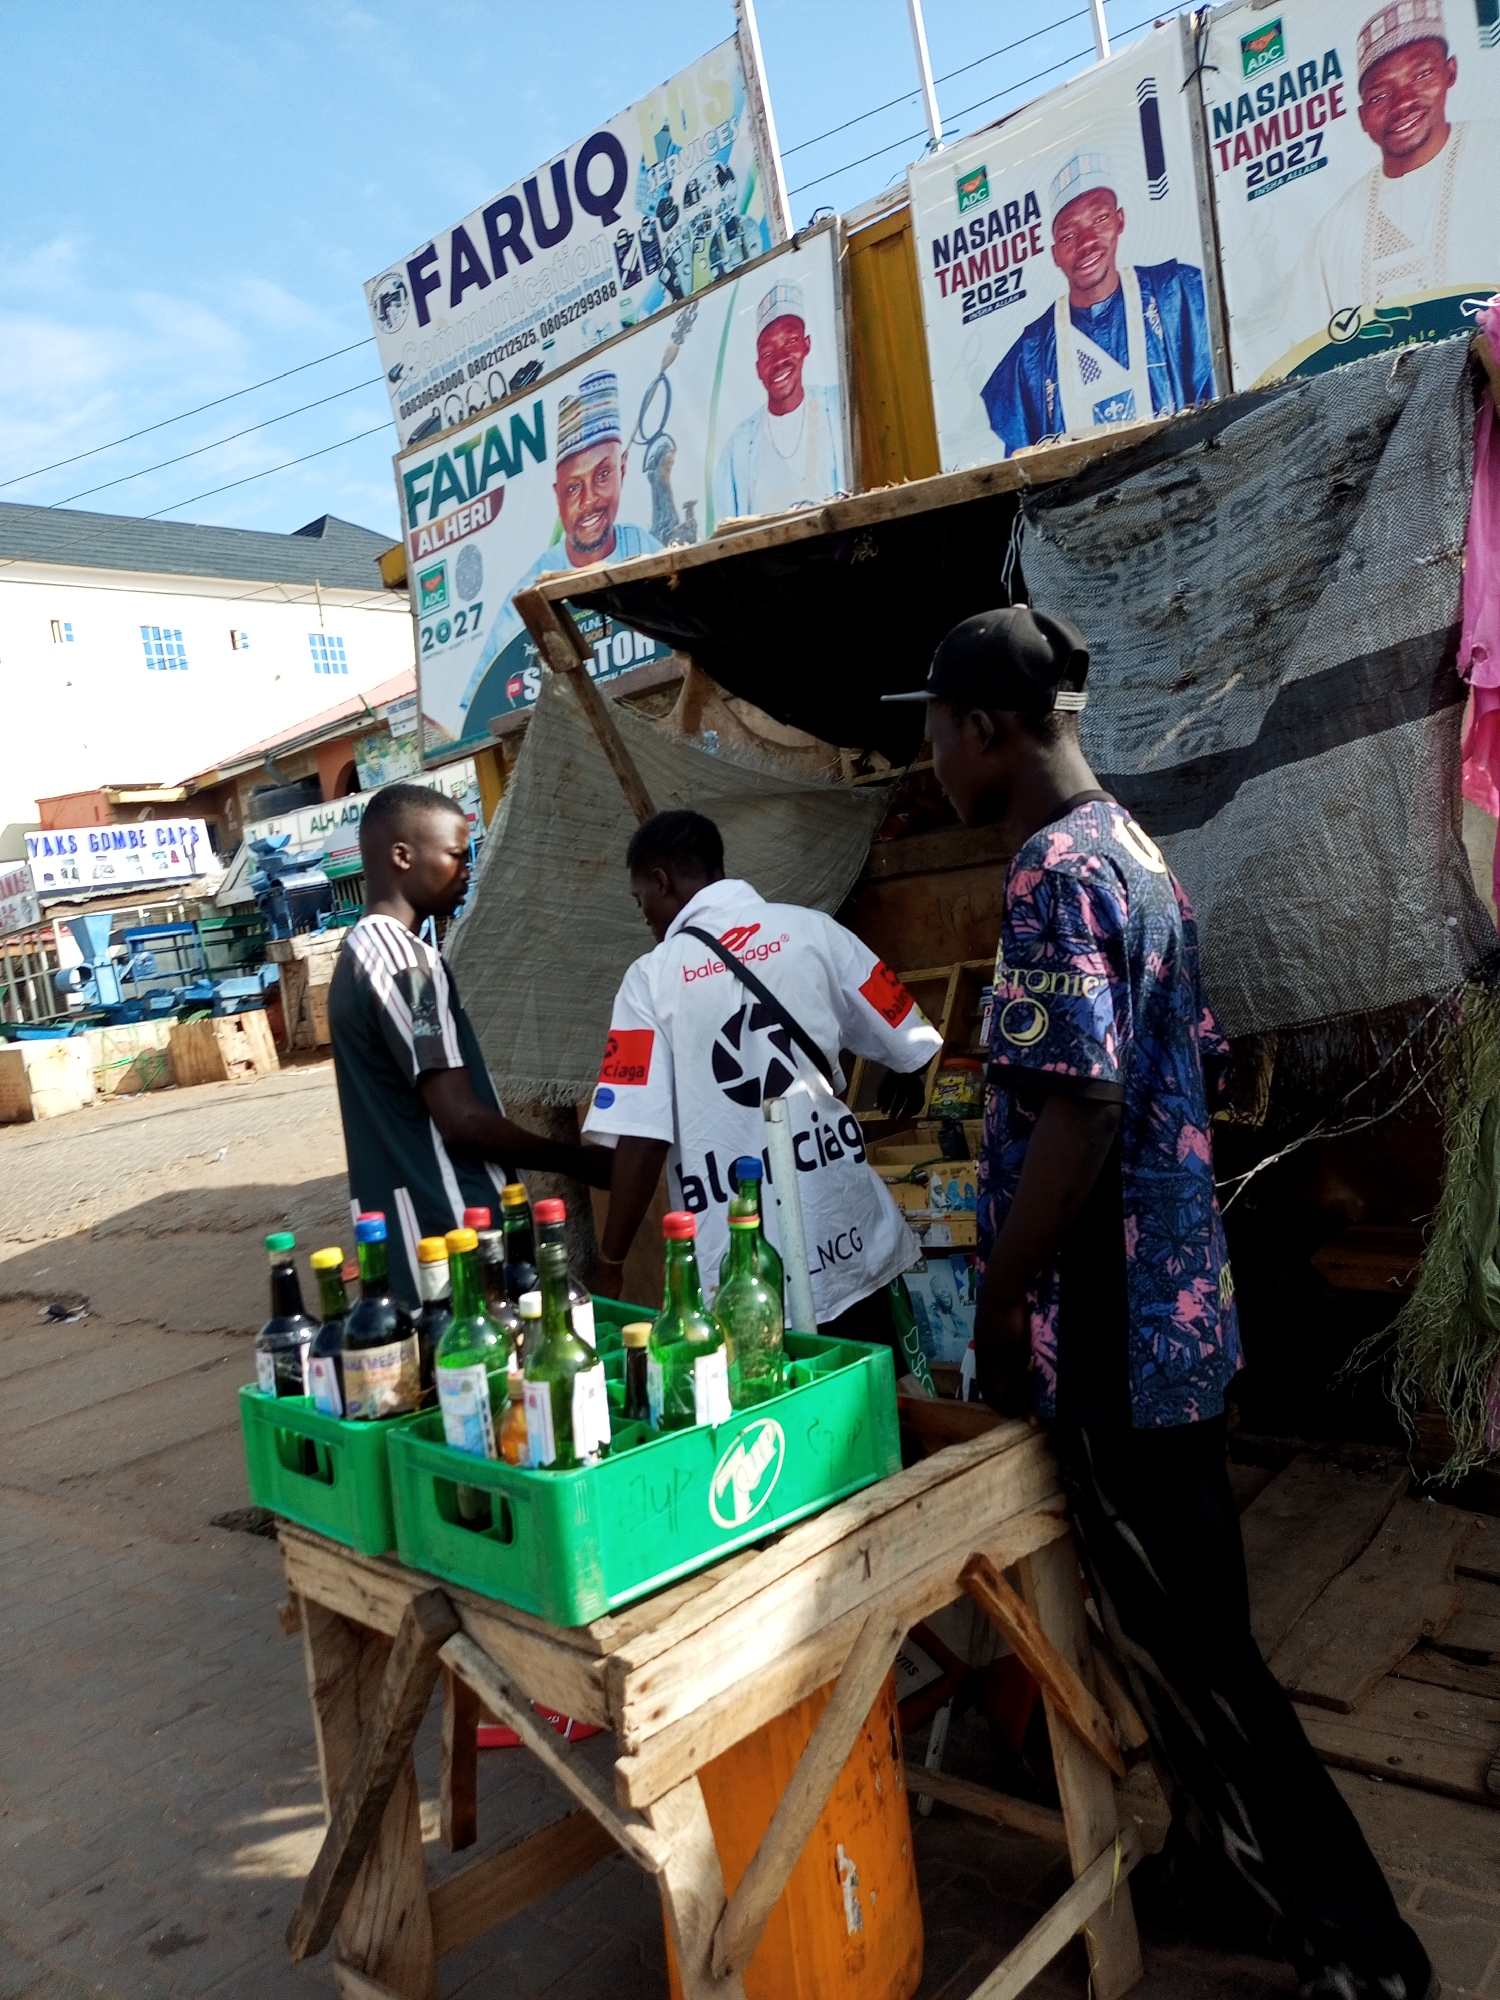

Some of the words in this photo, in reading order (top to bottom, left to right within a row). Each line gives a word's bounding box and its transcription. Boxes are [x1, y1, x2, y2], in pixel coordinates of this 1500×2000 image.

[1212, 48, 1344, 140] NASARA
[1246, 45, 1281, 74] ADC
[635, 55, 735, 169] POS
[1213, 81, 1348, 173] TAMUCE
[647, 116, 740, 193] SERVICES
[1246, 131, 1325, 188] 2027
[406, 131, 628, 328] FARUQ
[932, 190, 1042, 269] NASARA
[961, 188, 988, 211] ADC
[935, 221, 1045, 298] TAMUCE
[962, 266, 1023, 314] 2027
[402, 233, 611, 379] Communication
[403, 399, 547, 530] FATAN
[417, 496, 493, 557] ALHERI
[421, 601, 484, 654] 2027
[424, 589, 445, 608] ADC
[28, 834, 78, 858] YAKS
[88, 829, 147, 853] GOMBE
[155, 825, 200, 847] CAPS
